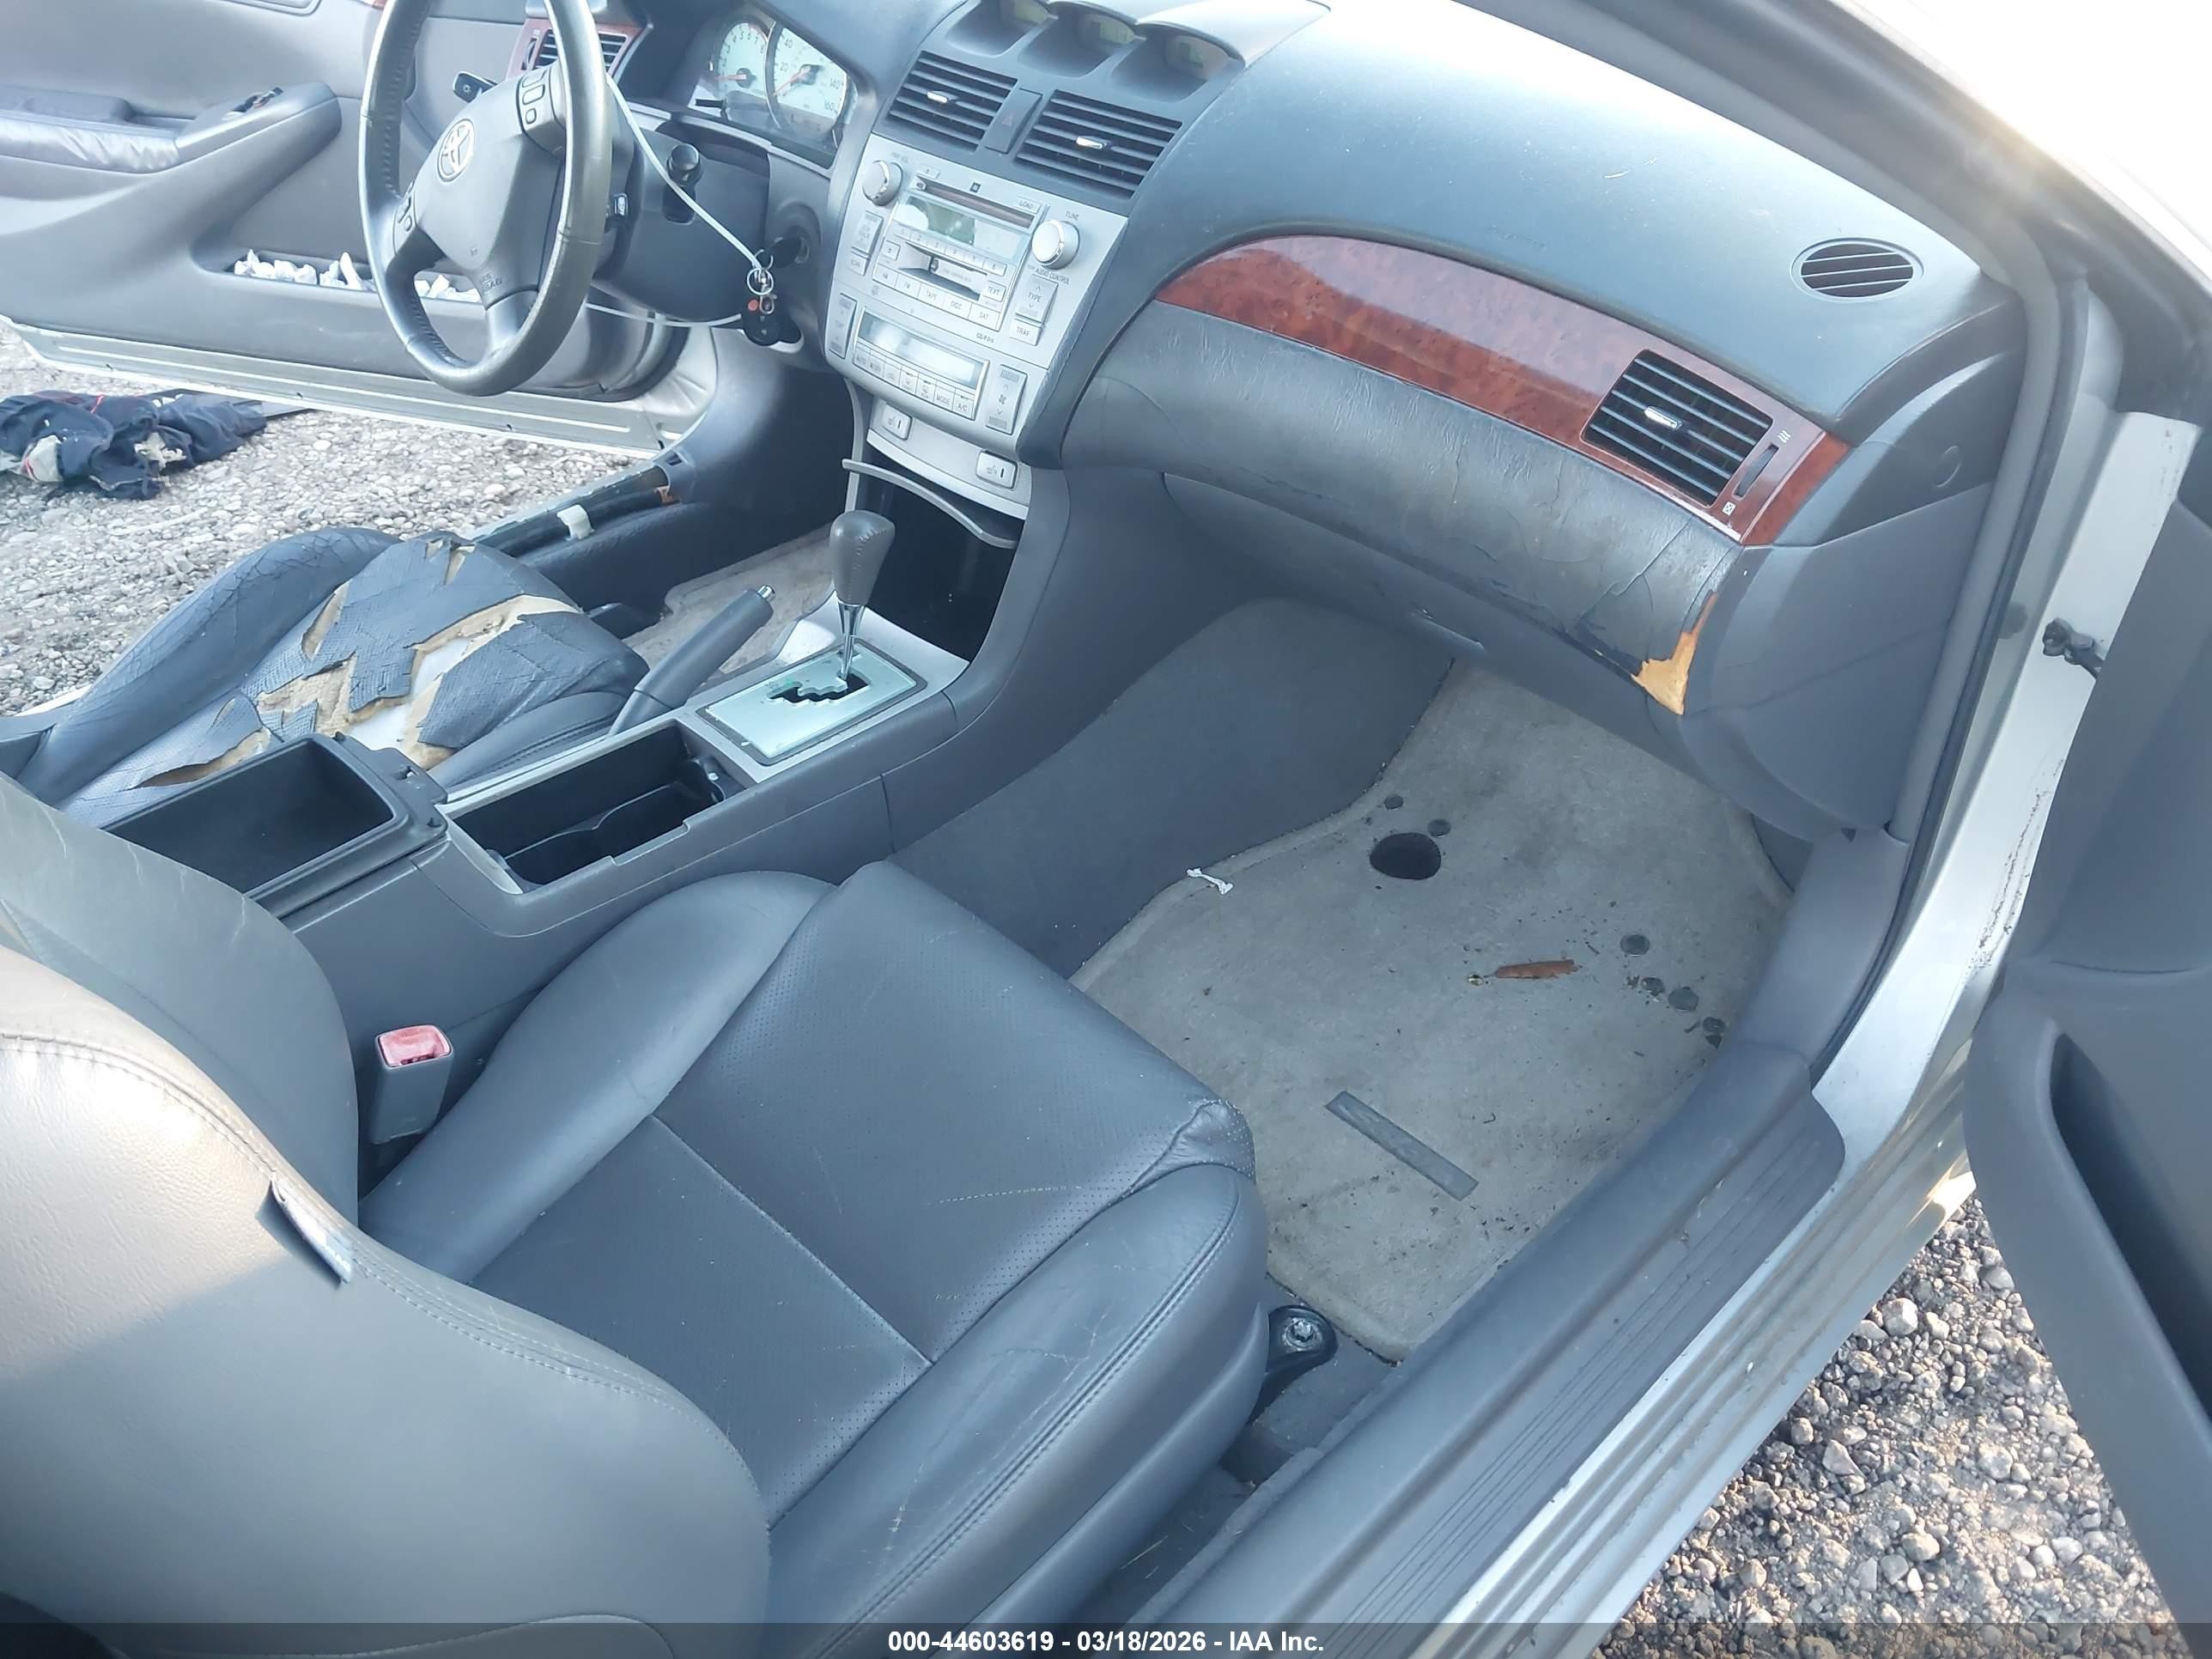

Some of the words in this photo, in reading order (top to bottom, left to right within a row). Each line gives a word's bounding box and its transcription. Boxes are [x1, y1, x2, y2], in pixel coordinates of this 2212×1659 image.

[783, 39, 793, 49] 40
[829, 77, 841, 90] 140
[823, 99, 836, 111] 160
[1065, 210, 1079, 220] TUNE
[1049, 273, 1070, 285] CONTROL
[926, 290, 938, 301] TAPE
[988, 285, 1000, 296] TEXT
[1028, 292, 1042, 303] TYPE
[951, 301, 963, 311] DISC
[979, 311, 989, 319] SAT
[936, 394, 951, 405] MODE
[957, 403, 968, 412] A/C
